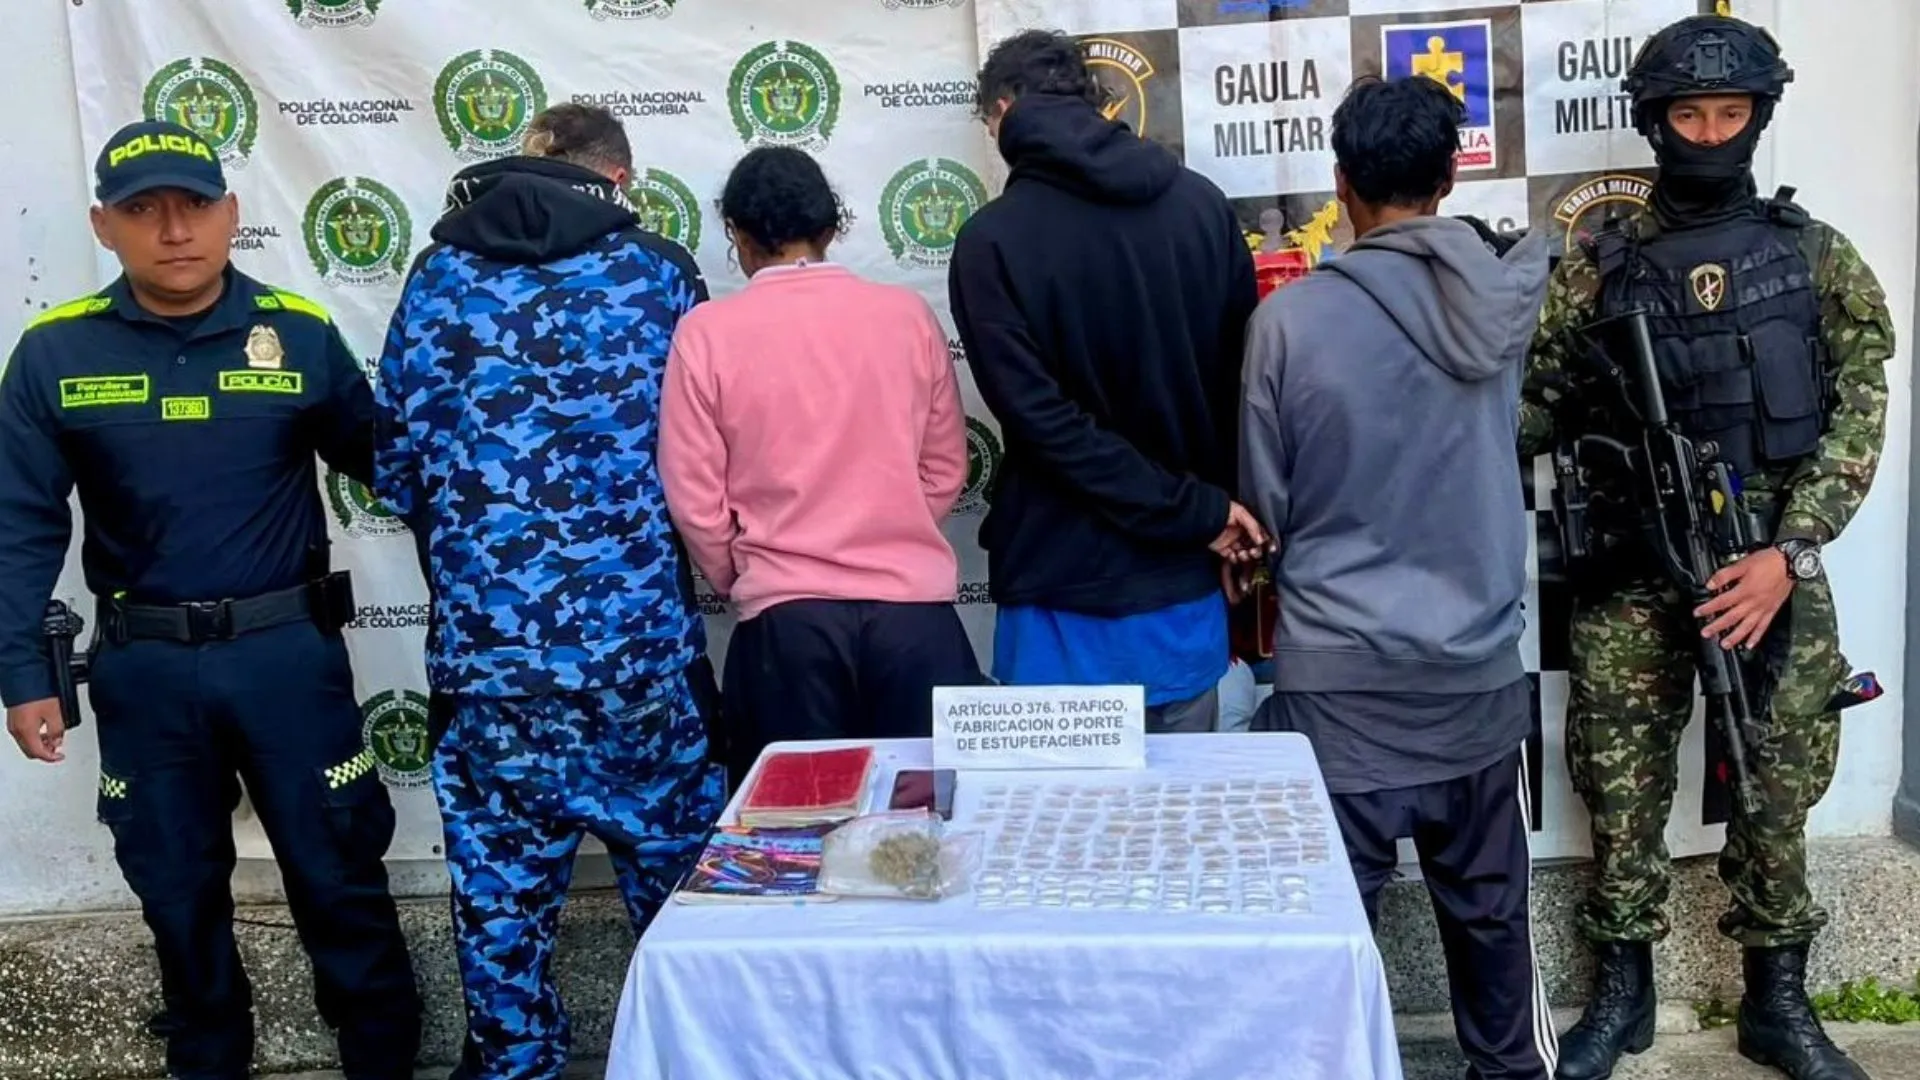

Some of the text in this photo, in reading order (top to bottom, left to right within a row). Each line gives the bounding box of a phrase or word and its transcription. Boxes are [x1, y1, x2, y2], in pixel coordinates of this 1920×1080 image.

[1089, 43, 1142, 72] MILITAR
[1558, 36, 1632, 82] GAUL
[863, 80, 978, 96] POLICÍA NACION
[1215, 59, 1321, 106] GAULA
[278, 98, 415, 114] POLICÍA NACIONAL
[571, 90, 706, 105] POLICÍA NACIONAL
[881, 96, 902, 108] DE
[297, 111, 400, 126] DE COLOMBIA
[612, 103, 689, 117] COLOMBIA
[1555, 95, 1633, 134] MILIT
[1213, 116, 1325, 158] MILITAR
[1563, 179, 1652, 214] GAULA MILIT
[238, 225, 281, 238] IONAL
[358, 603, 431, 617] ICÍA NACIO
[370, 615, 430, 629] COLOMB
[948, 699, 1128, 717] ARTÍCULO 376. TRAFICO,
[953, 715, 1124, 734] FABRICACION O PORTE
[957, 732, 1121, 751] DE ESTUPEFACIENTES
